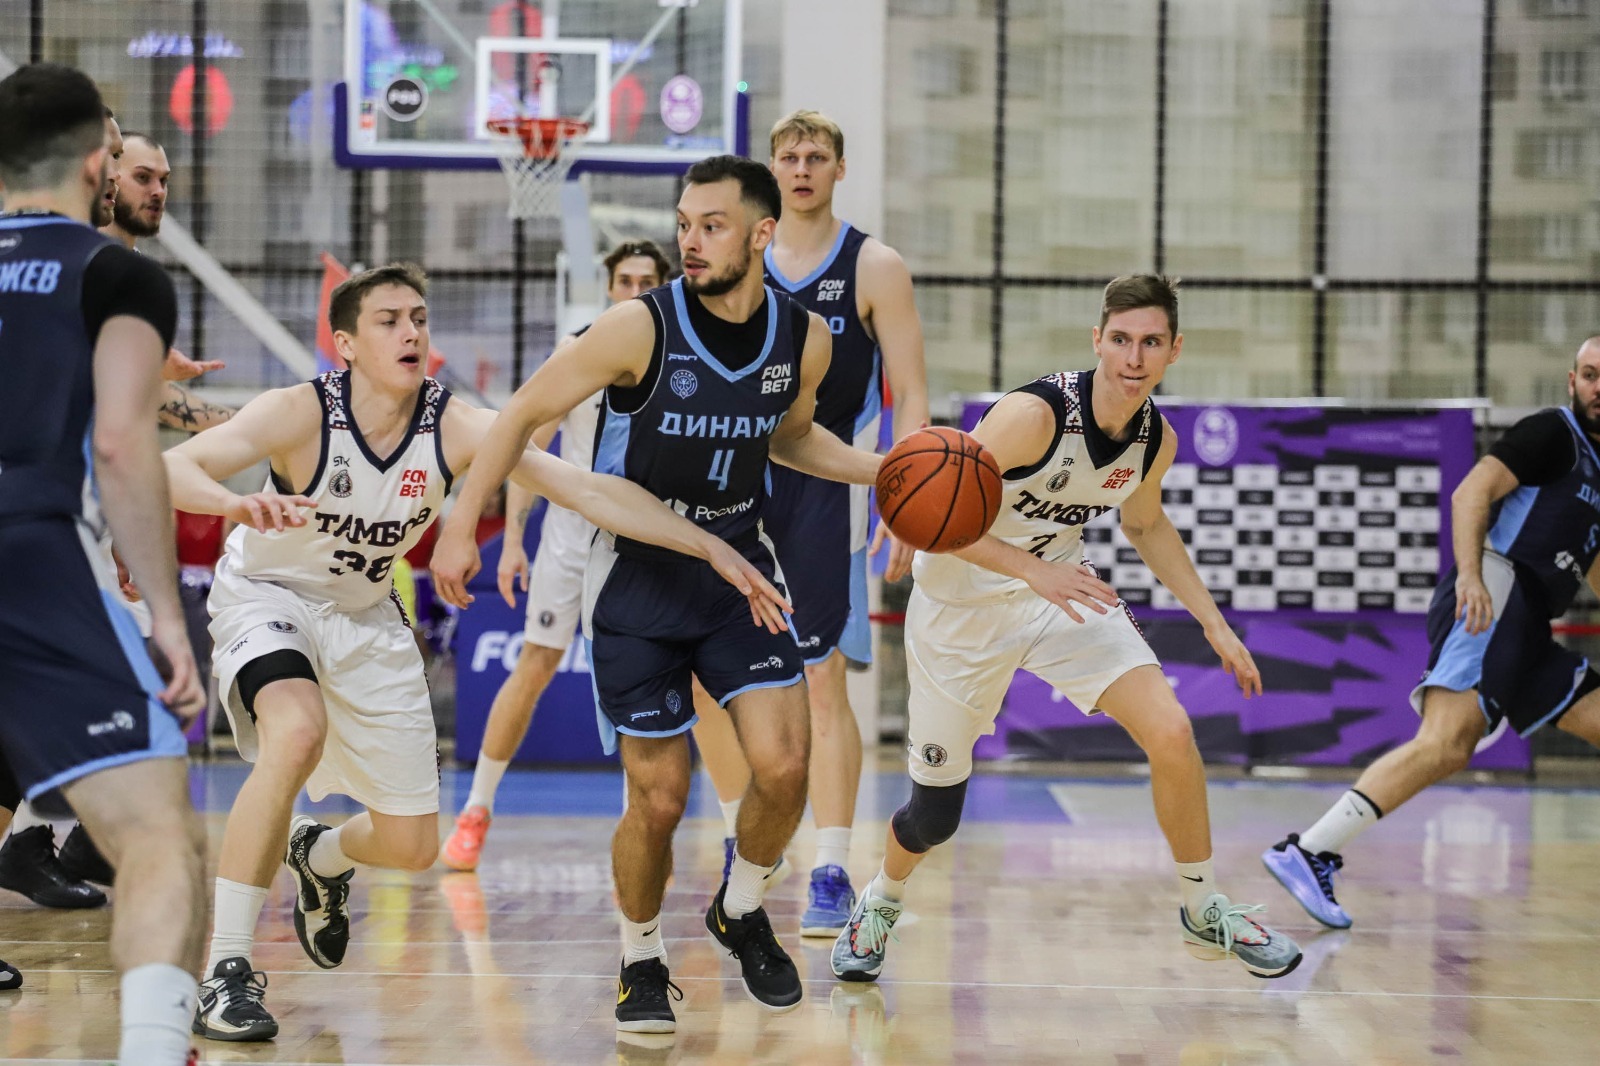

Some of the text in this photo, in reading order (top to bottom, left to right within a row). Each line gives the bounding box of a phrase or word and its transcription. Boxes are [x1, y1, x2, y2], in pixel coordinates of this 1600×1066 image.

[817, 279, 846, 291] FON
[816, 290, 845, 302] BET
[761, 362, 791, 380] FON
[760, 377, 793, 395] BET
[401, 469, 427, 483] FON
[707, 449, 735, 491] 4
[1108, 467, 1136, 479] FON
[1101, 478, 1129, 489] BET
[399, 484, 426, 498] BET
[328, 549, 397, 583] 38
